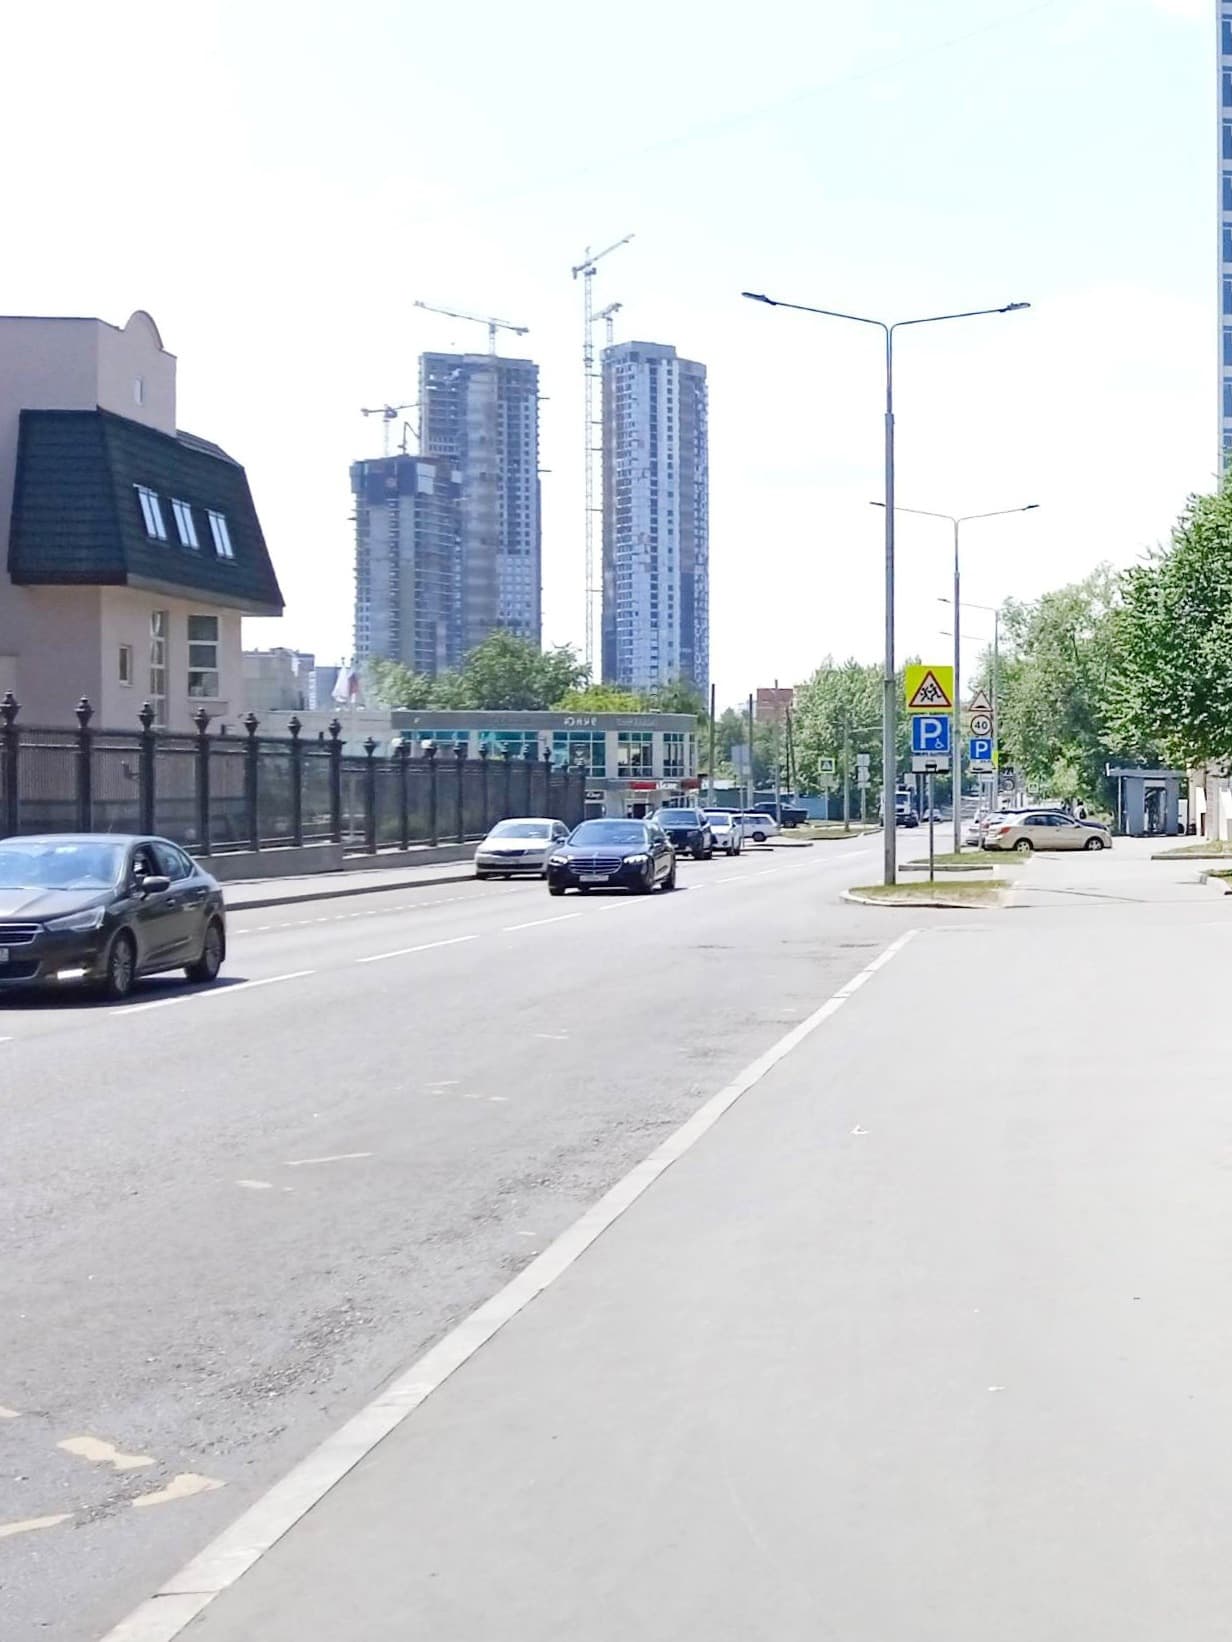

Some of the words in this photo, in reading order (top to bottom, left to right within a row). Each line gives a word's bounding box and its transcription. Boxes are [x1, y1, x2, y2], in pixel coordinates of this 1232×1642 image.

[974, 720, 988, 730] 40
[920, 719, 943, 749] P
[975, 741, 988, 758] P
